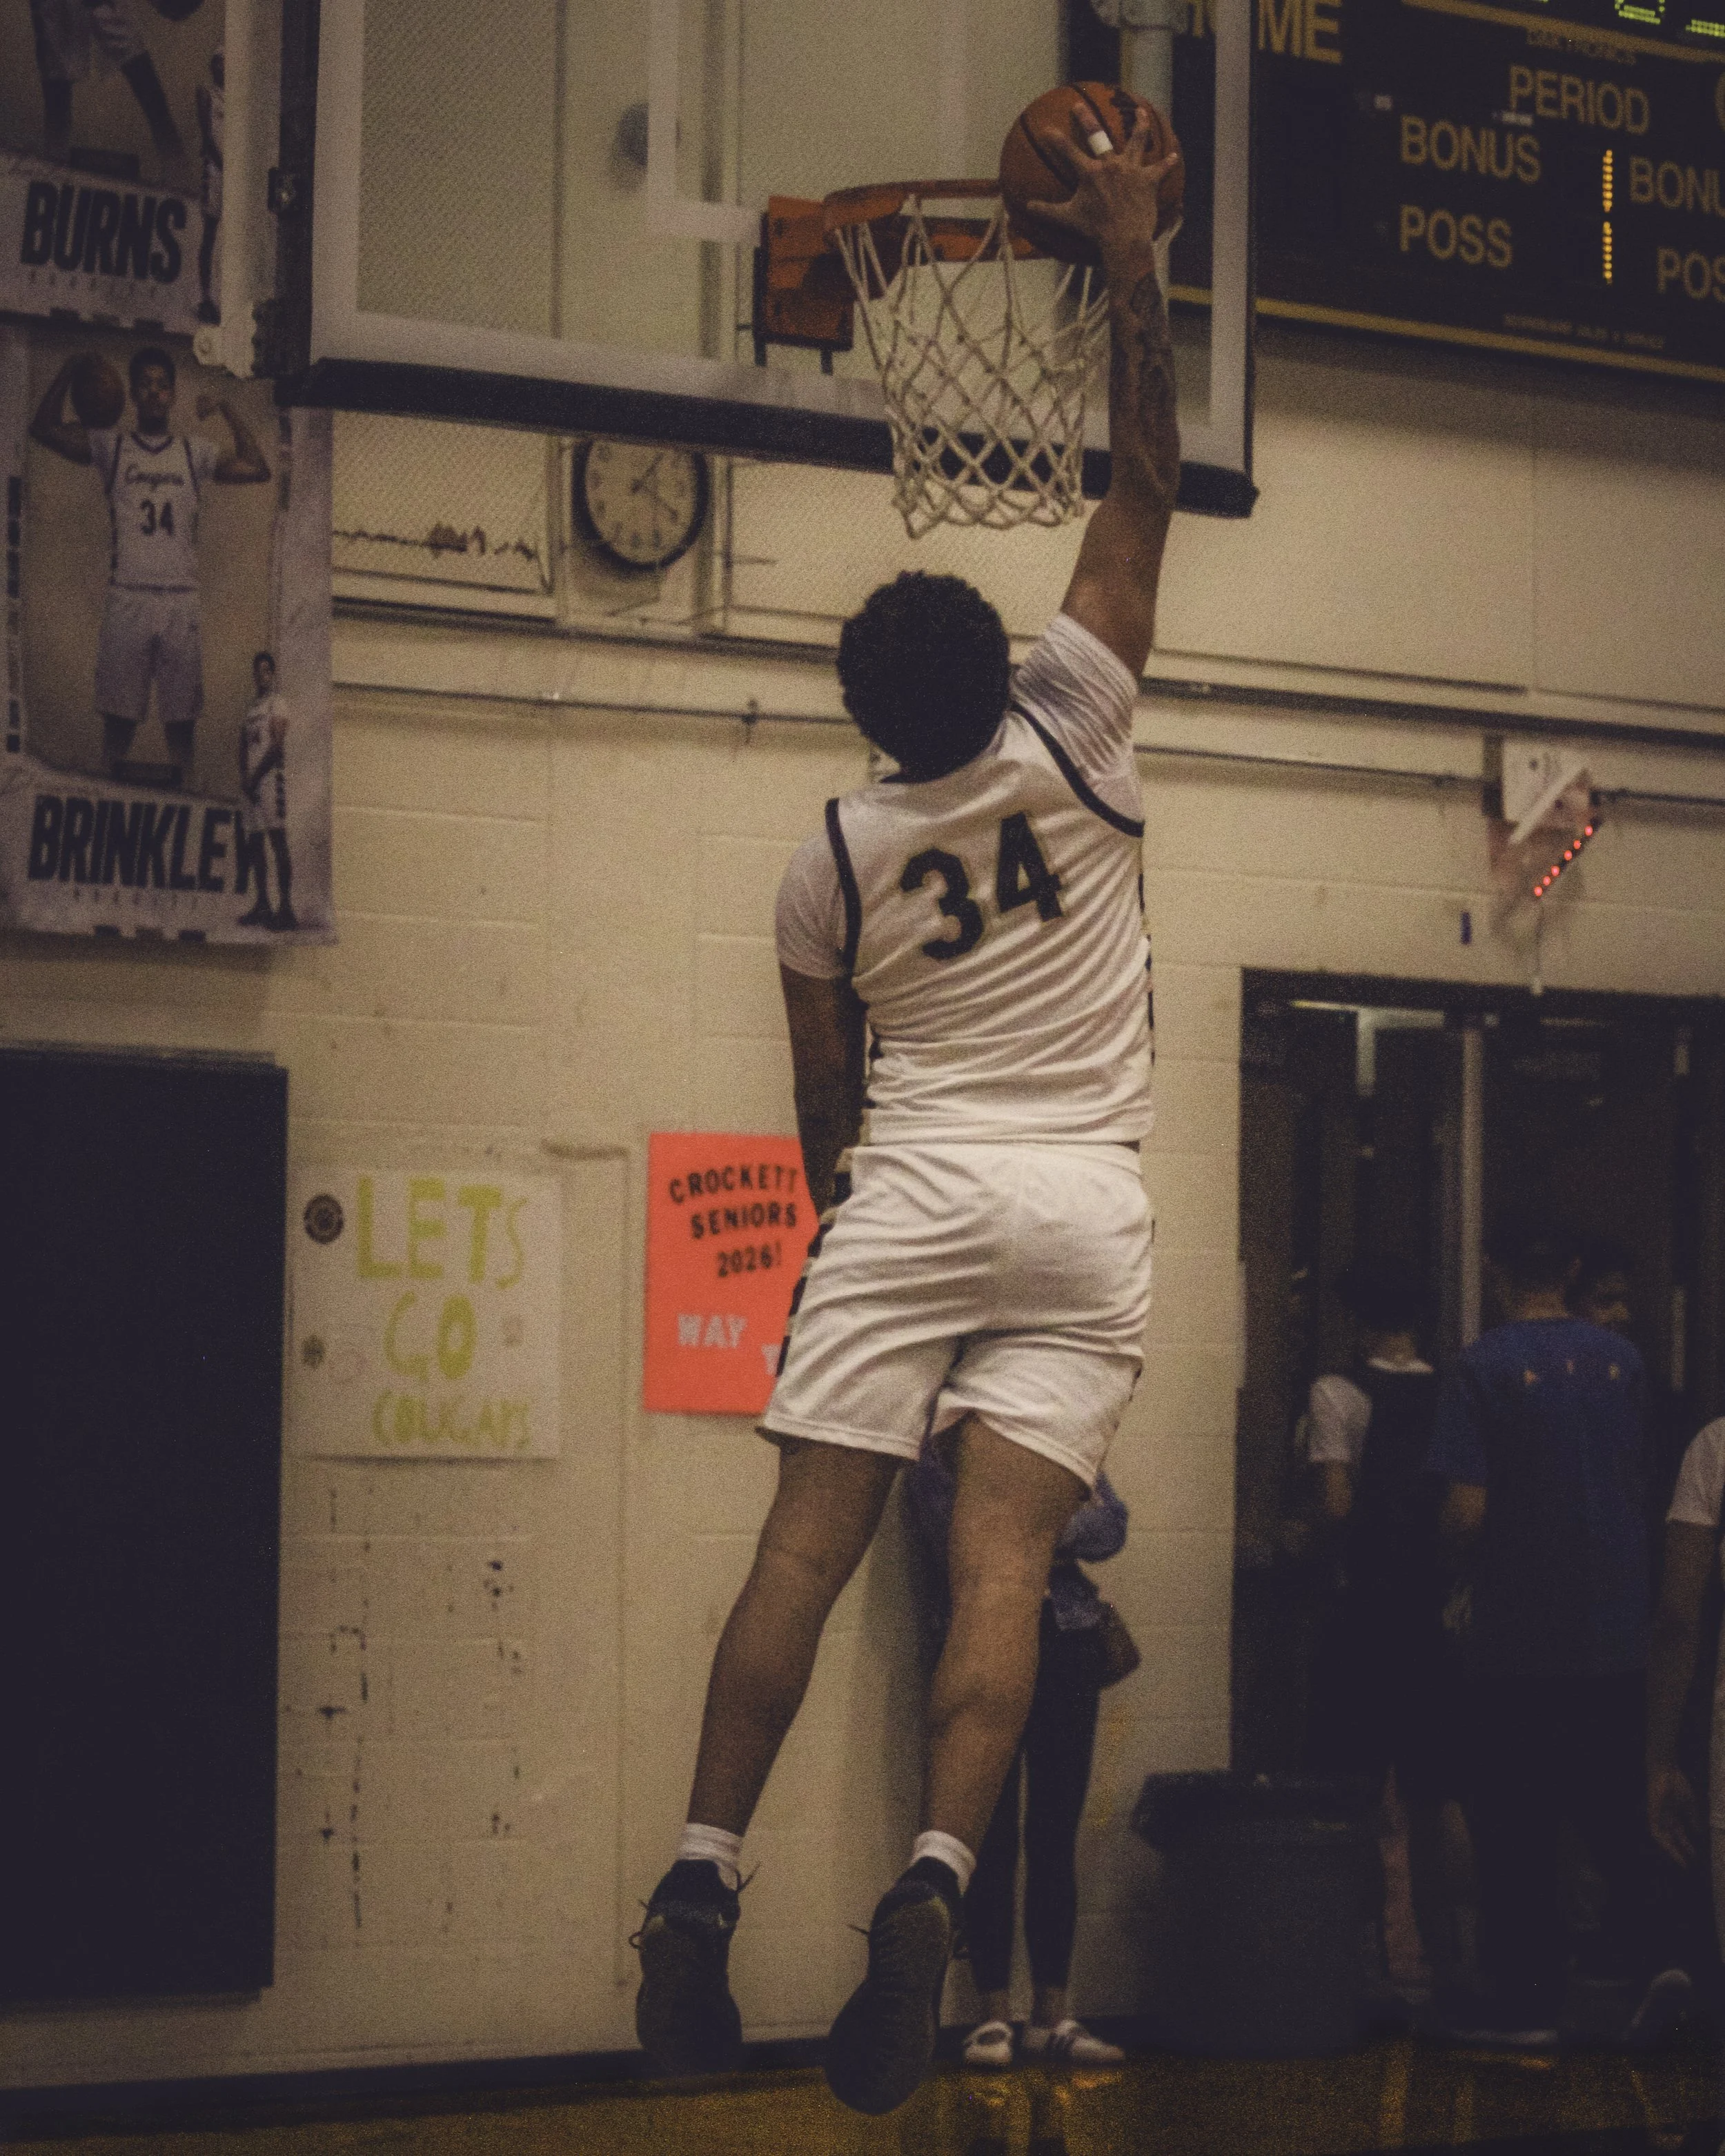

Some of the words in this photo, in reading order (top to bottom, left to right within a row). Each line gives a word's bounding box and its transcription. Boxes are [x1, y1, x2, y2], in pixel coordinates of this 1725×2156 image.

[1508, 64, 1650, 135] PERIOD
[1400, 114, 1541, 184] BONUS
[21, 180, 187, 284] BURNS
[1399, 205, 1513, 268] POSS
[140, 498, 175, 537] 34
[899, 811, 1067, 964] 34
[668, 1162, 798, 1207] CROCKETT
[356, 1175, 529, 1291] LETS
[691, 1200, 798, 1240] SENIORS
[716, 1240, 783, 1280] 2026!
[384, 1289, 476, 1384] GO
[677, 1312, 747, 1349] WAY
